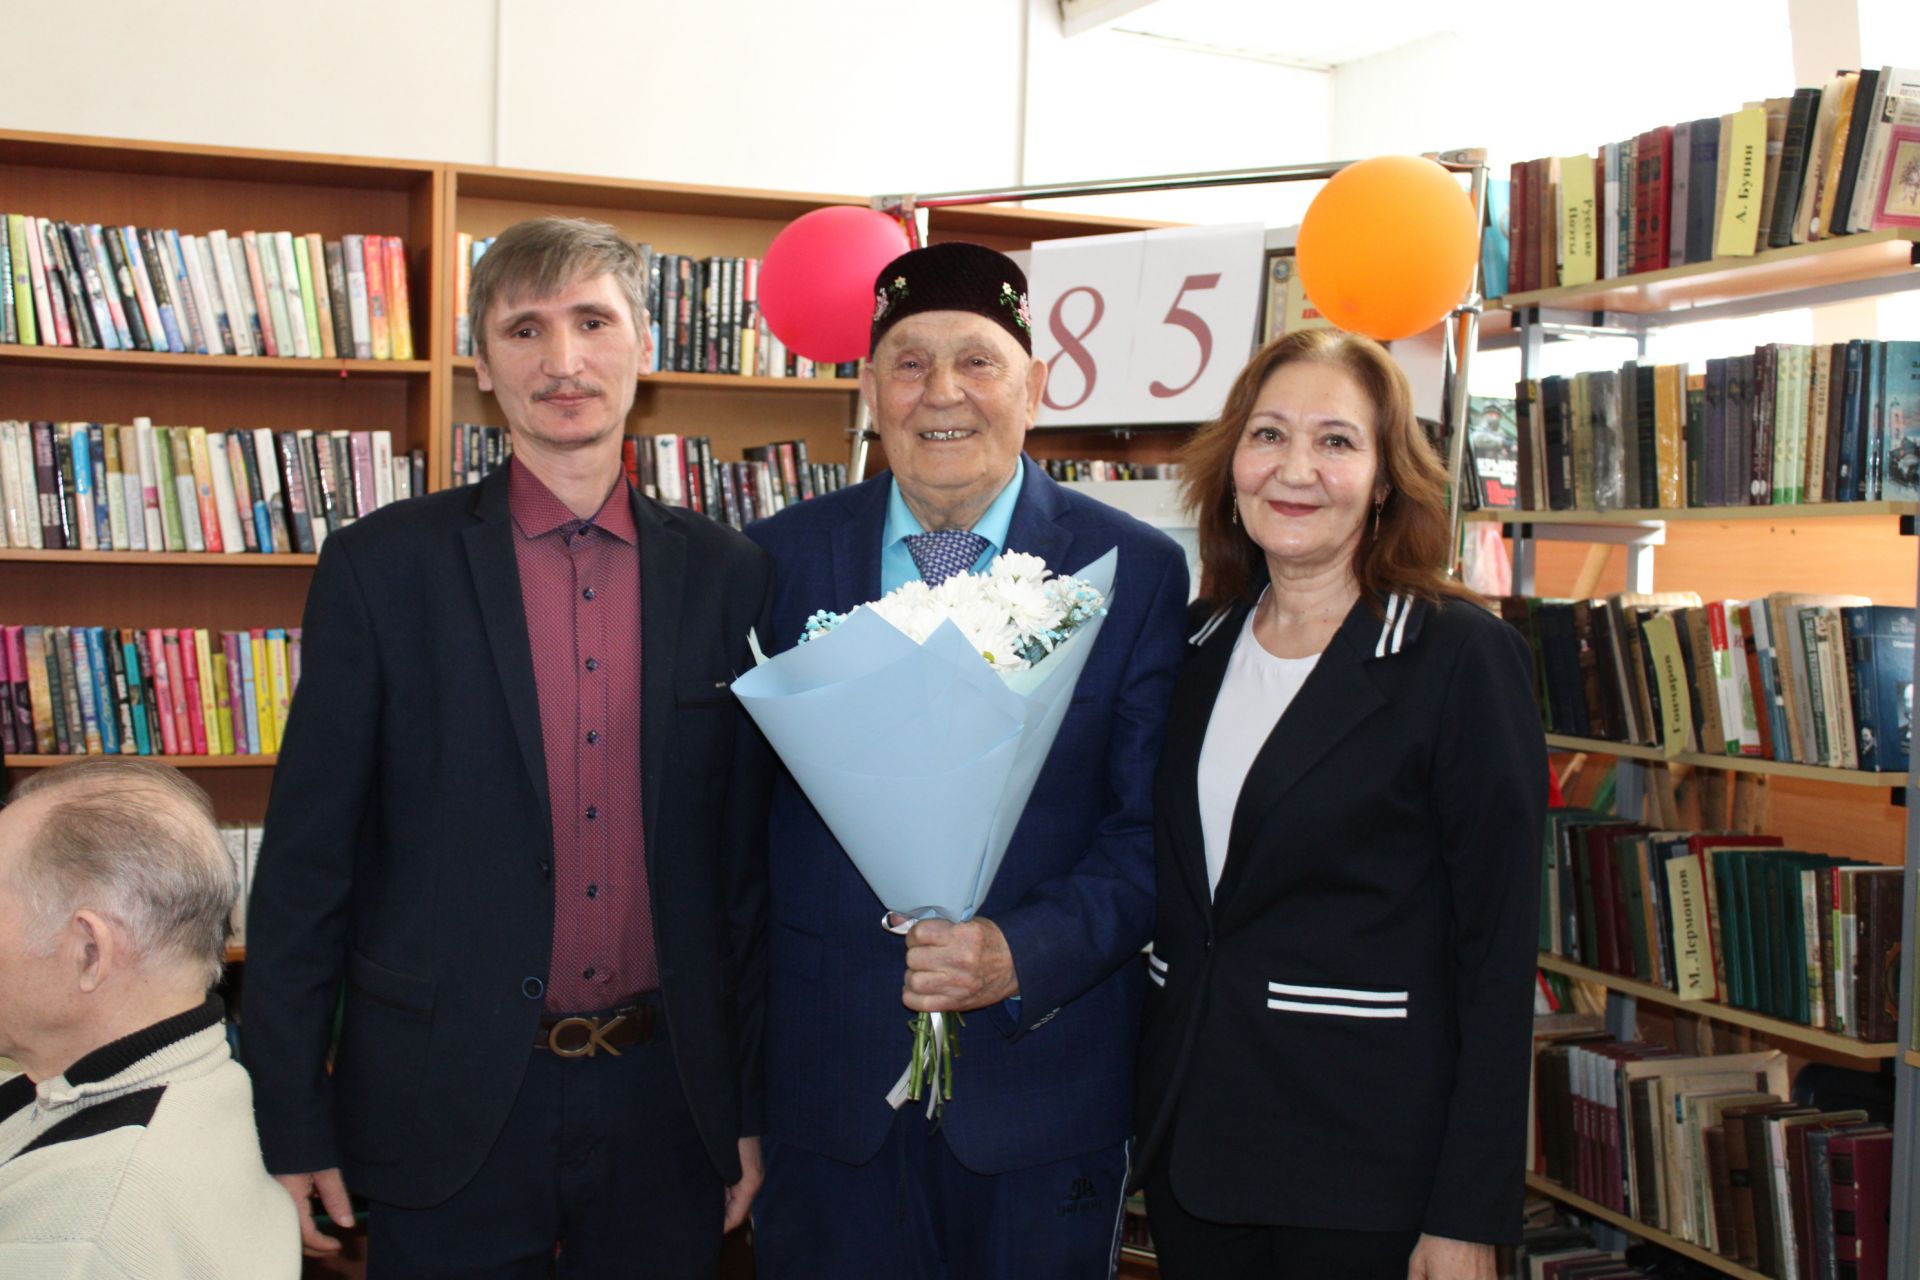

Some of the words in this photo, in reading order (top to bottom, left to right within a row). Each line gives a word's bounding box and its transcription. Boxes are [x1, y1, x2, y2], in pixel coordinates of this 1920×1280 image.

[1738, 145, 1754, 199] Бунин
[1568, 207, 1578, 255] Поэты
[1581, 199, 1593, 257] Русские
[1665, 654, 1681, 733] Гончаров
[1679, 869, 1699, 962] Лермонтов
[1688, 966, 1701, 989] М.
